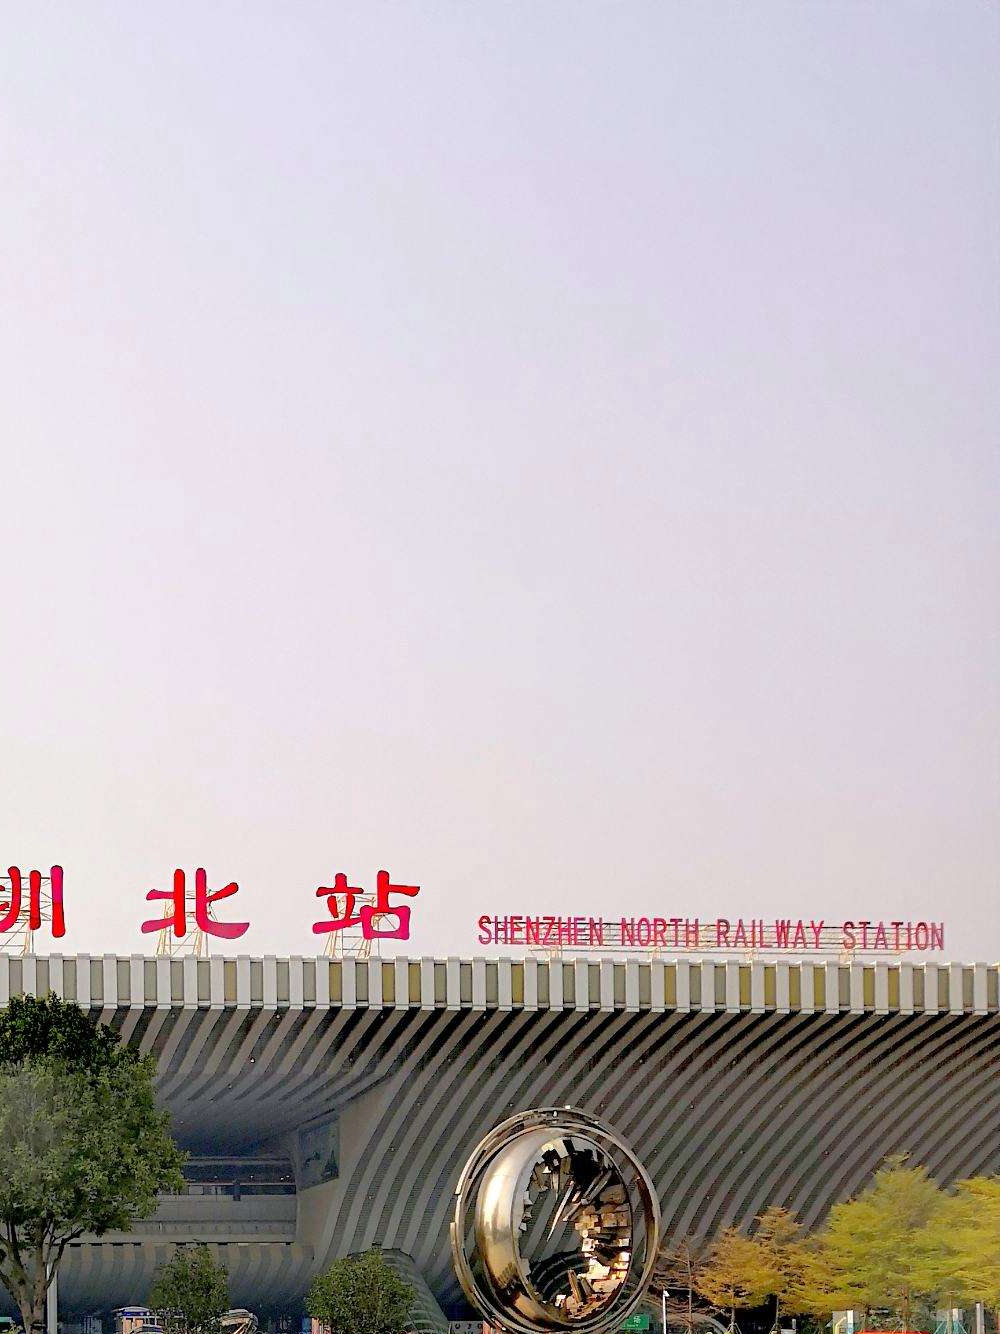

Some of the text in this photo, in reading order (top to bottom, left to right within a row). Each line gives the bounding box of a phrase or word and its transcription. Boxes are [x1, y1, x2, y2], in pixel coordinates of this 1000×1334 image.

[477, 915, 945, 951] SHENZHEN NORTH RAILWAY STATION
